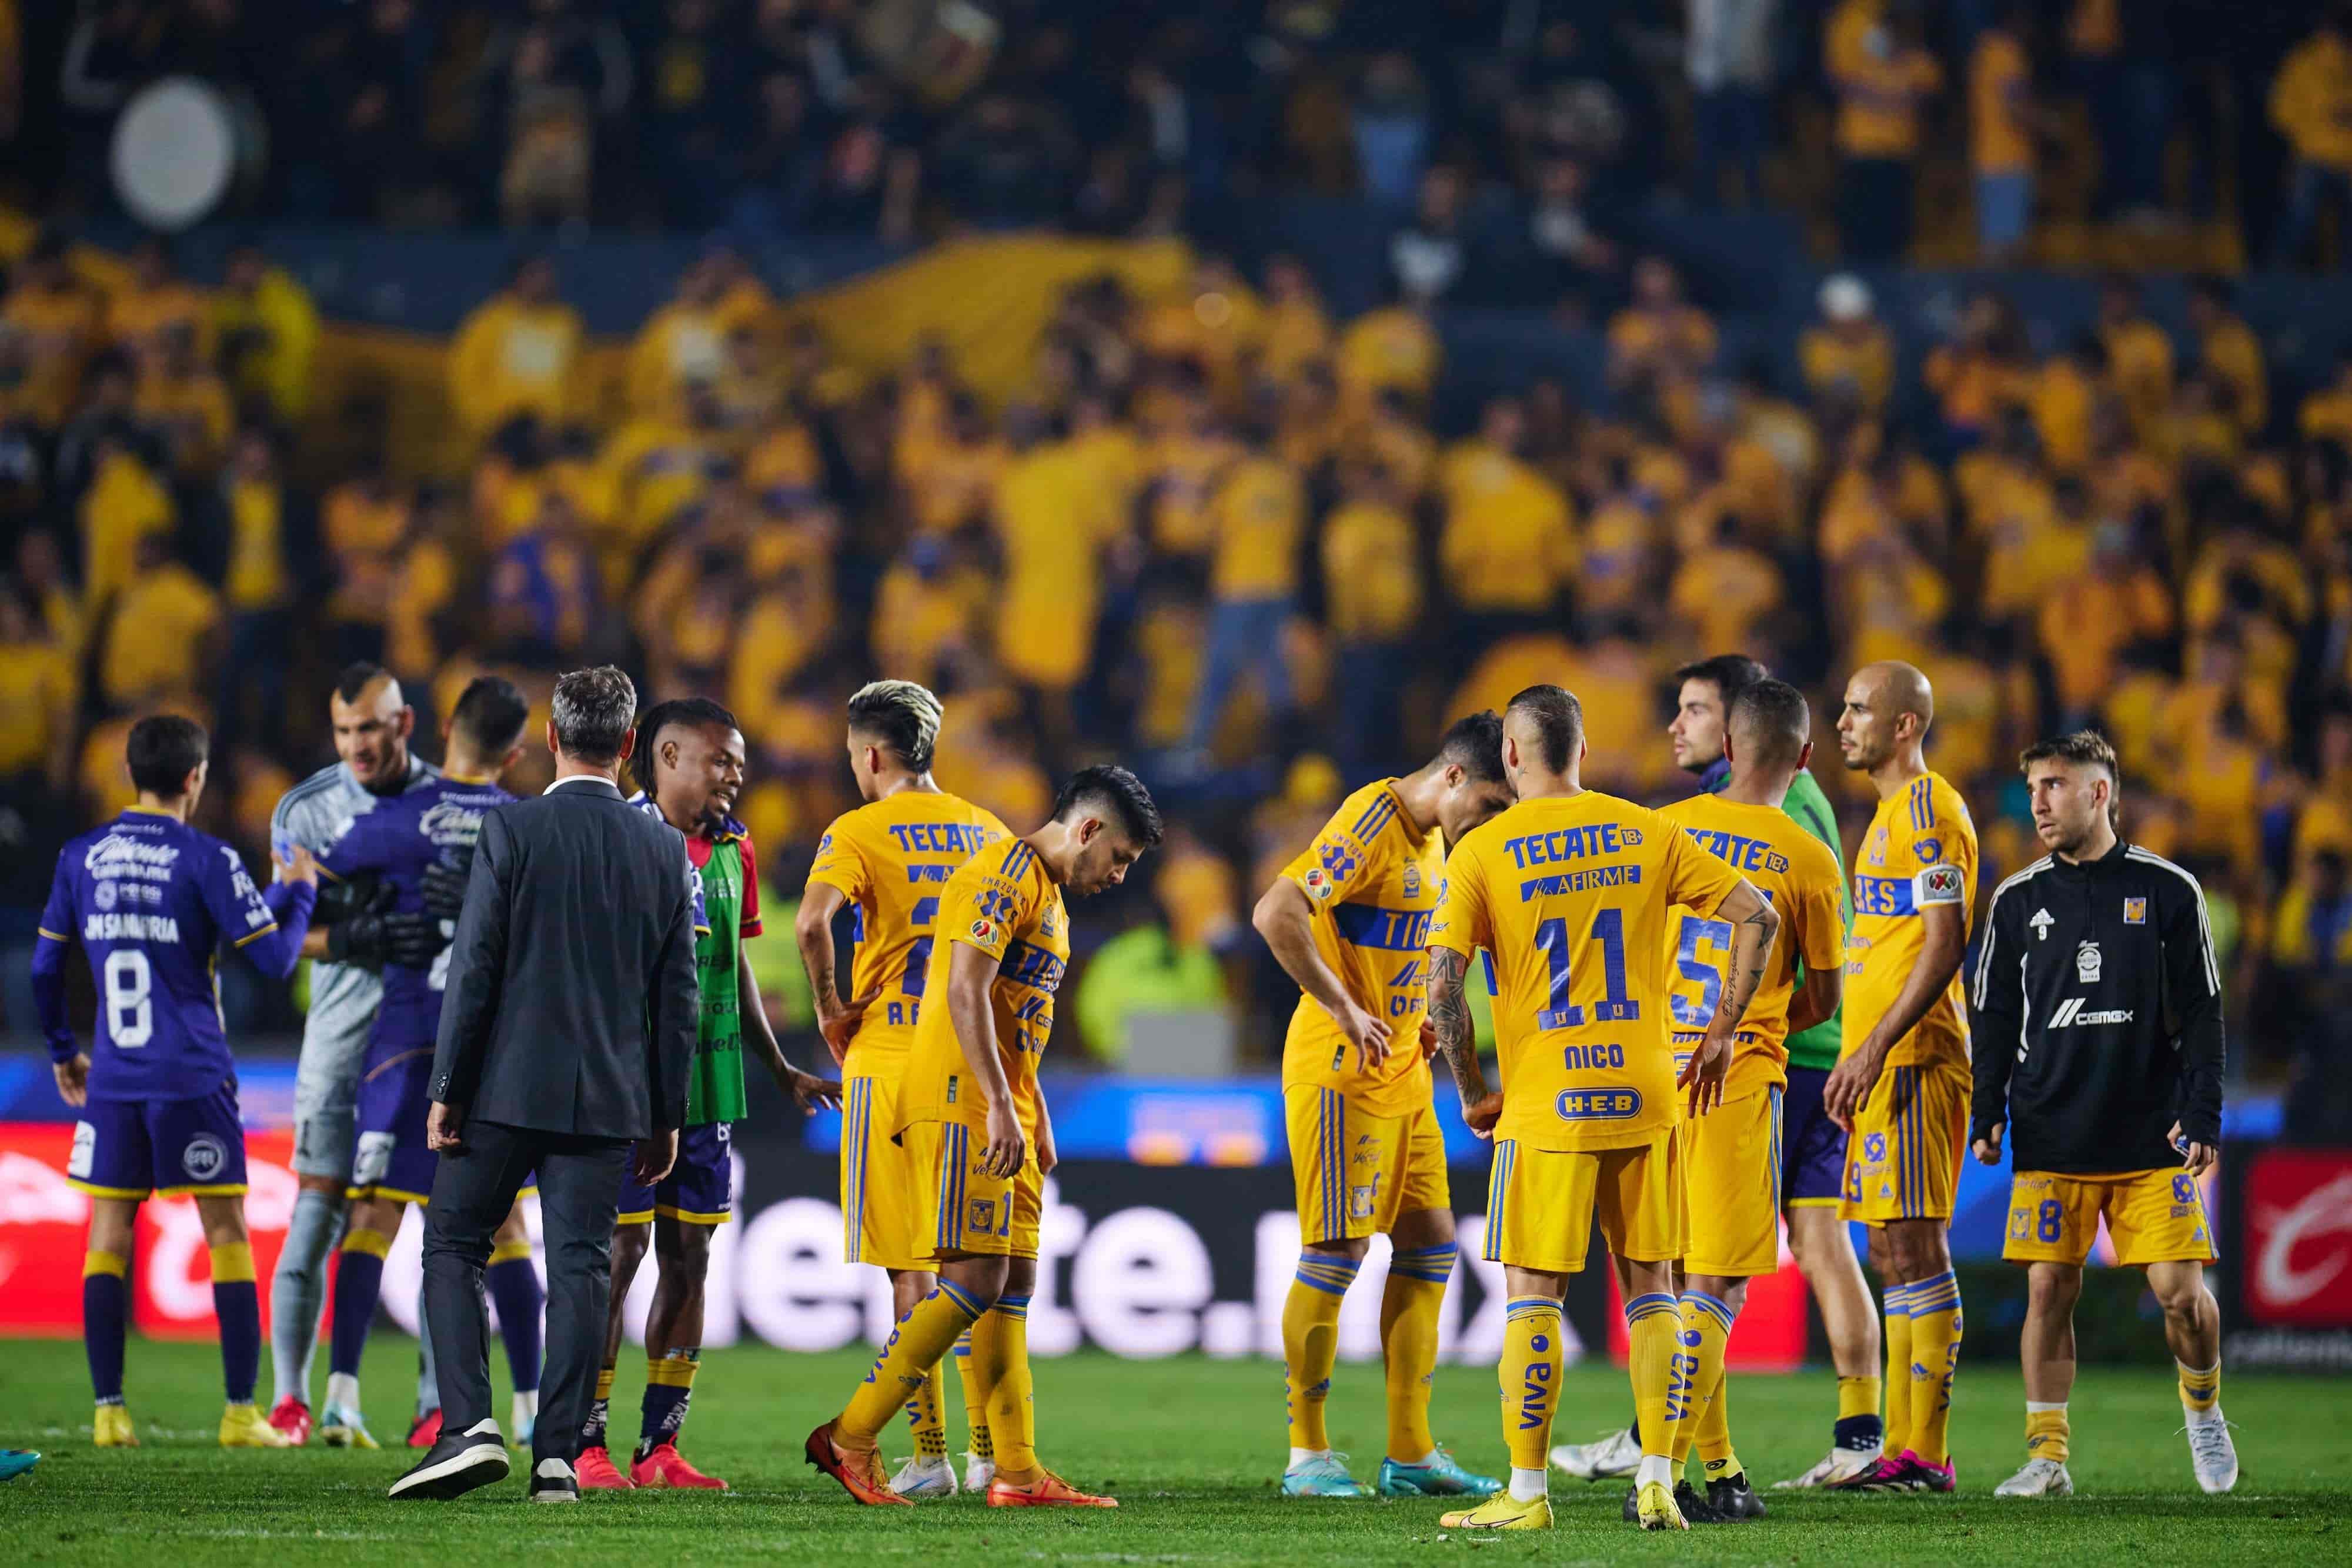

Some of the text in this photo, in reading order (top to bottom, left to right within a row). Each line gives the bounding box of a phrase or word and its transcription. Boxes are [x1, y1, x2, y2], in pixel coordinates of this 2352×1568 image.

[889, 823, 984, 857] TECATE
[1504, 823, 1642, 869] TECATE 18+
[1685, 828, 1788, 872] CATE 18+
[1558, 866, 1633, 895] AFIRME
[1530, 908, 1640, 1031] 11
[1670, 915, 1732, 1028] 5
[105, 950, 153, 1048] 8
[1564, 1044, 1625, 1069] NICO
[1564, 1095, 1633, 1113] H-E-B
[2038, 1199, 2063, 1243] 8
[1519, 1362, 1551, 1429] viva
[1665, 1353, 1686, 1421] viva
